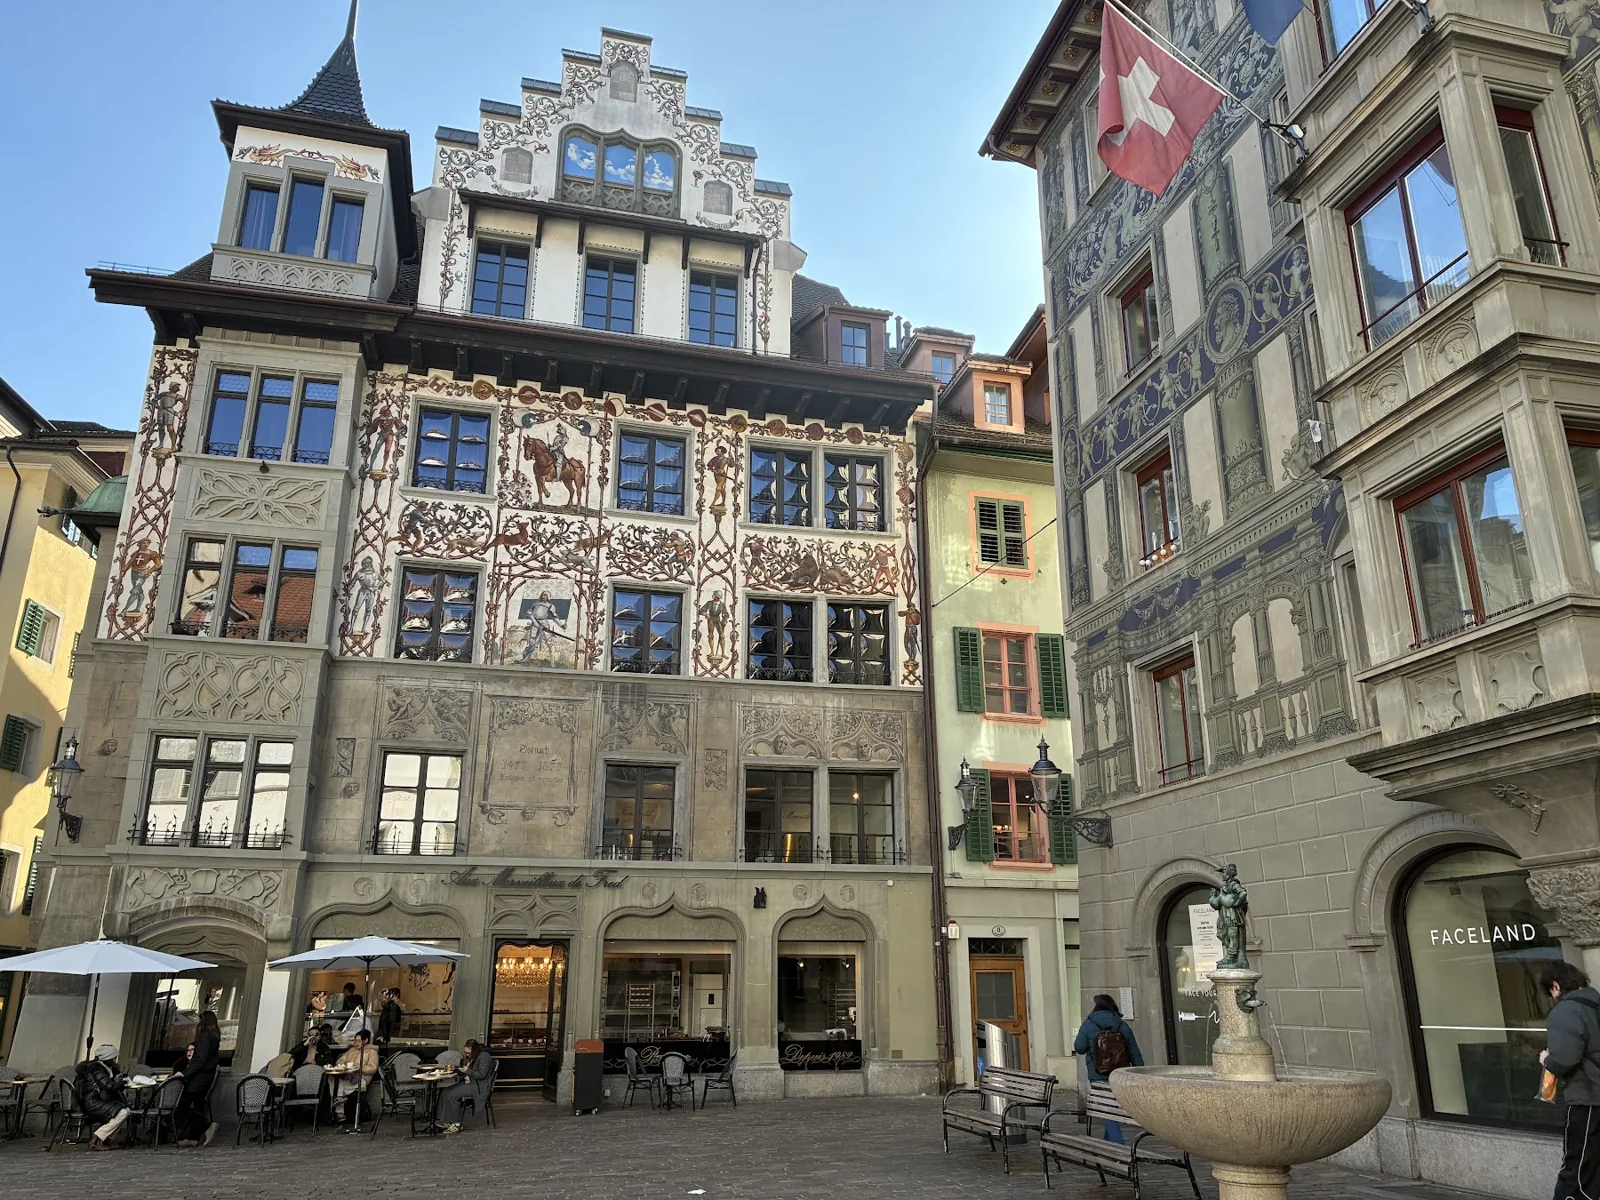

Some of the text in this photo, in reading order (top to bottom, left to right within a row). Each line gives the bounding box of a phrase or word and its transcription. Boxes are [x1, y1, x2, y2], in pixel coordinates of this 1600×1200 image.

[441, 866, 480, 887] Aux
[567, 874, 584, 888] de
[585, 869, 629, 888] Fred
[1430, 923, 1536, 946] FACELAND
[784, 1044, 826, 1066] Depuis
